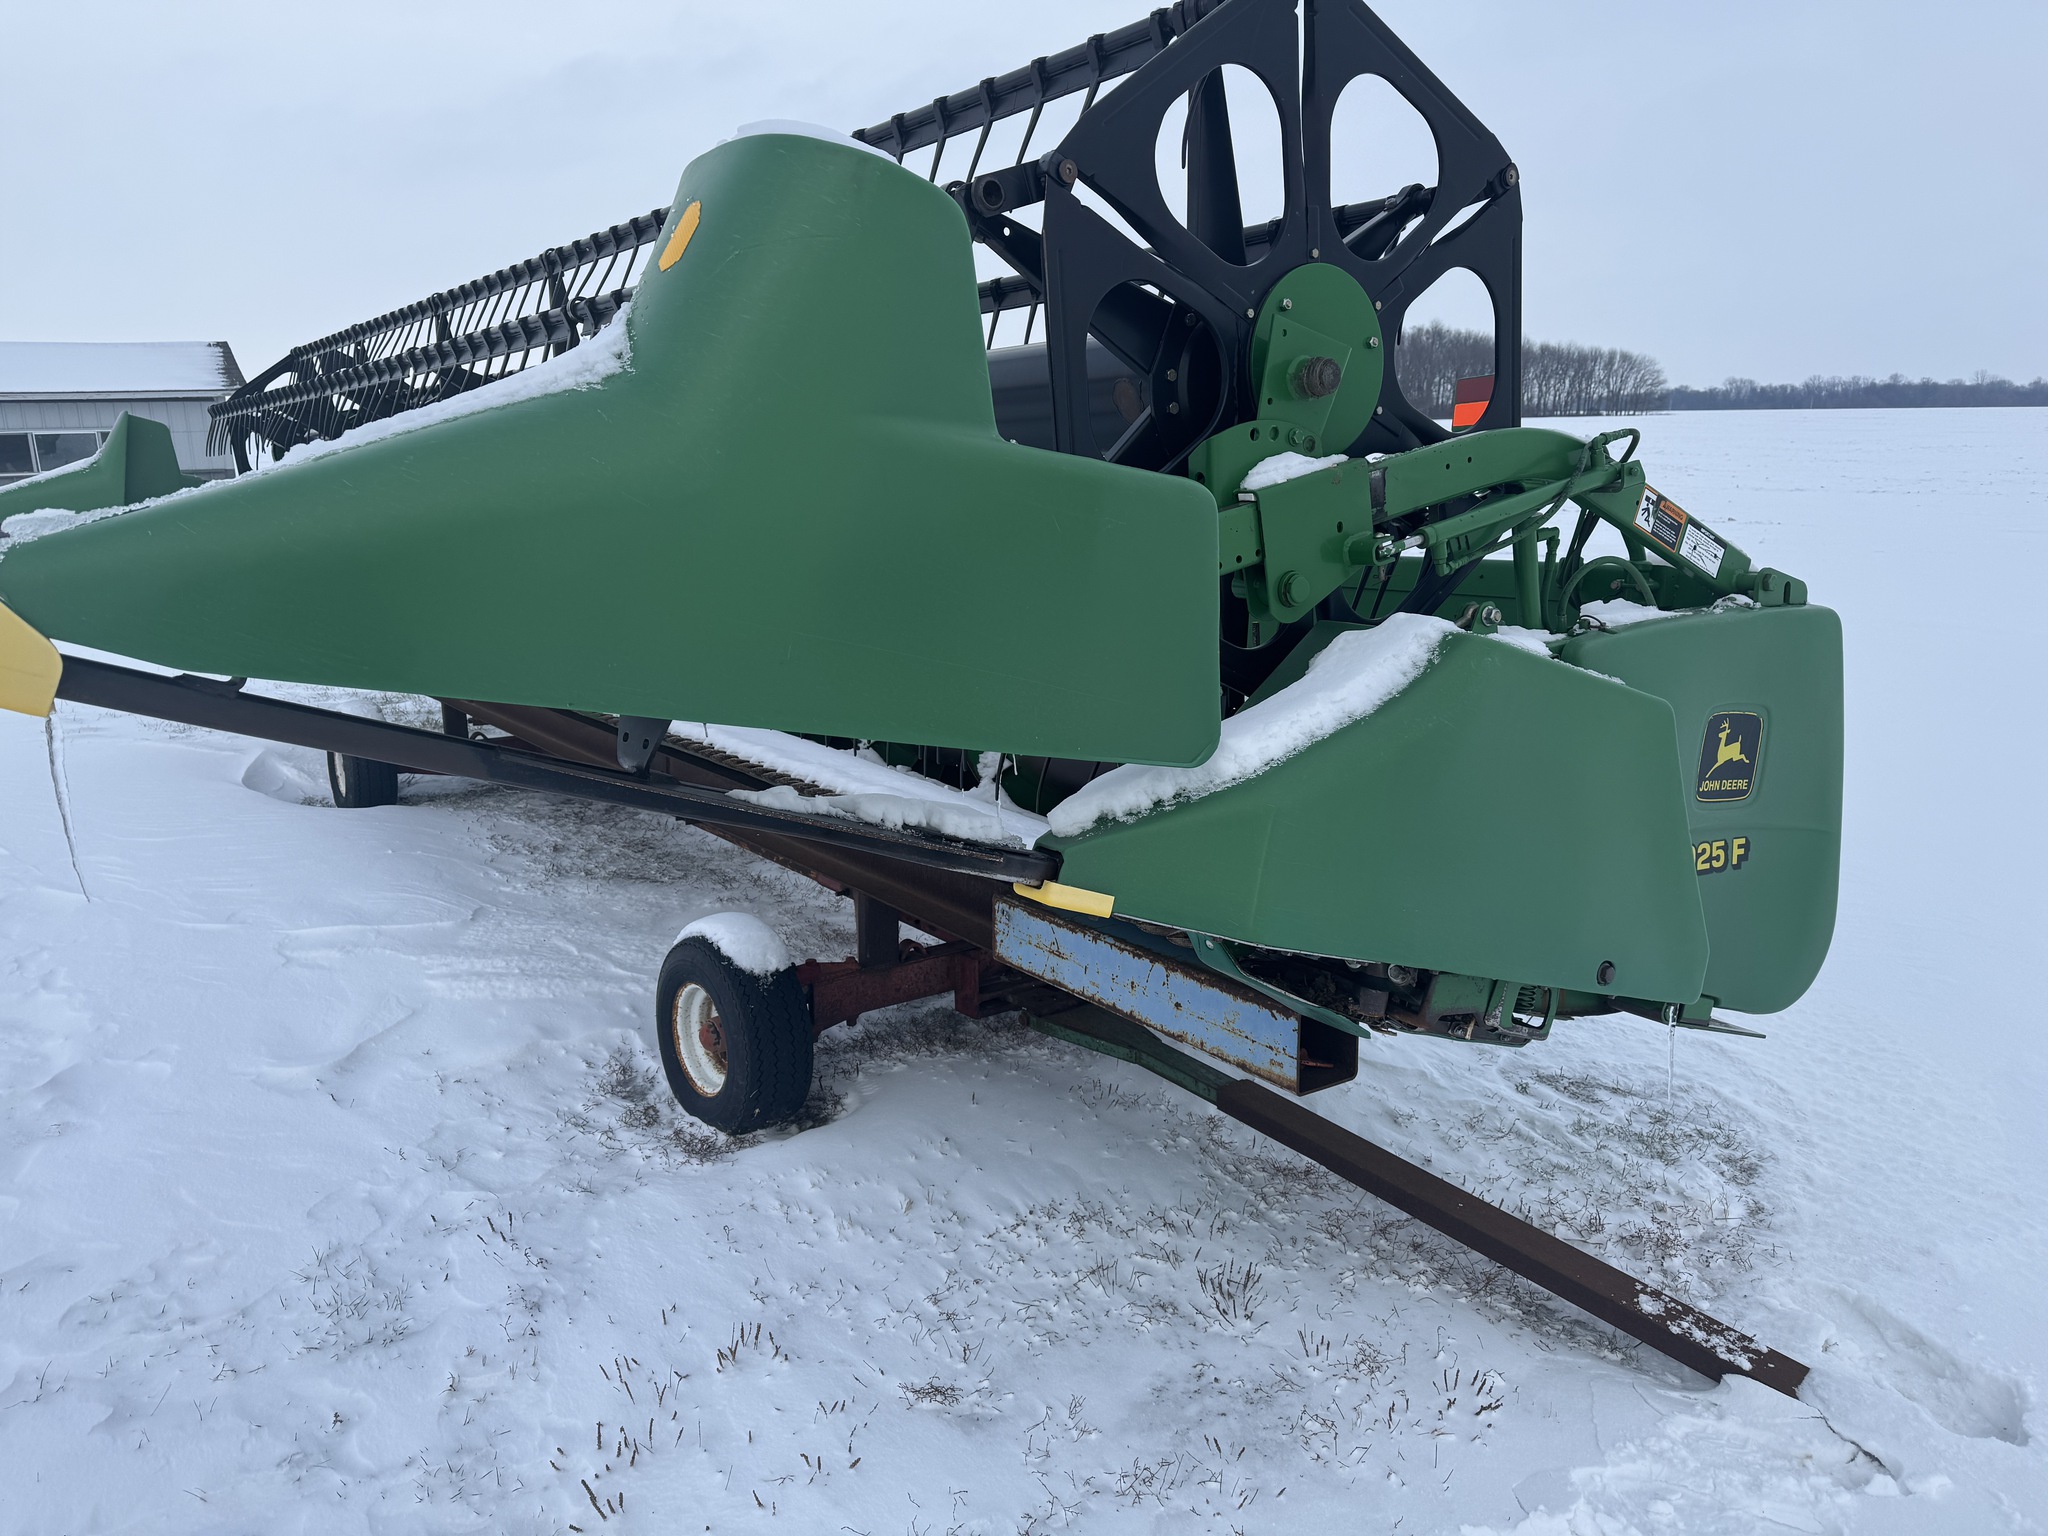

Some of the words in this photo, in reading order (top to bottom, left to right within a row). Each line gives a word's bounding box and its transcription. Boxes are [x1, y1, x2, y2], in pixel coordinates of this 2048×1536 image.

[1699, 780, 1720, 792] JOHN
[1721, 779, 1748, 791] DEERE
[1691, 840, 1727, 872] 25
[1732, 837, 1747, 867] F
